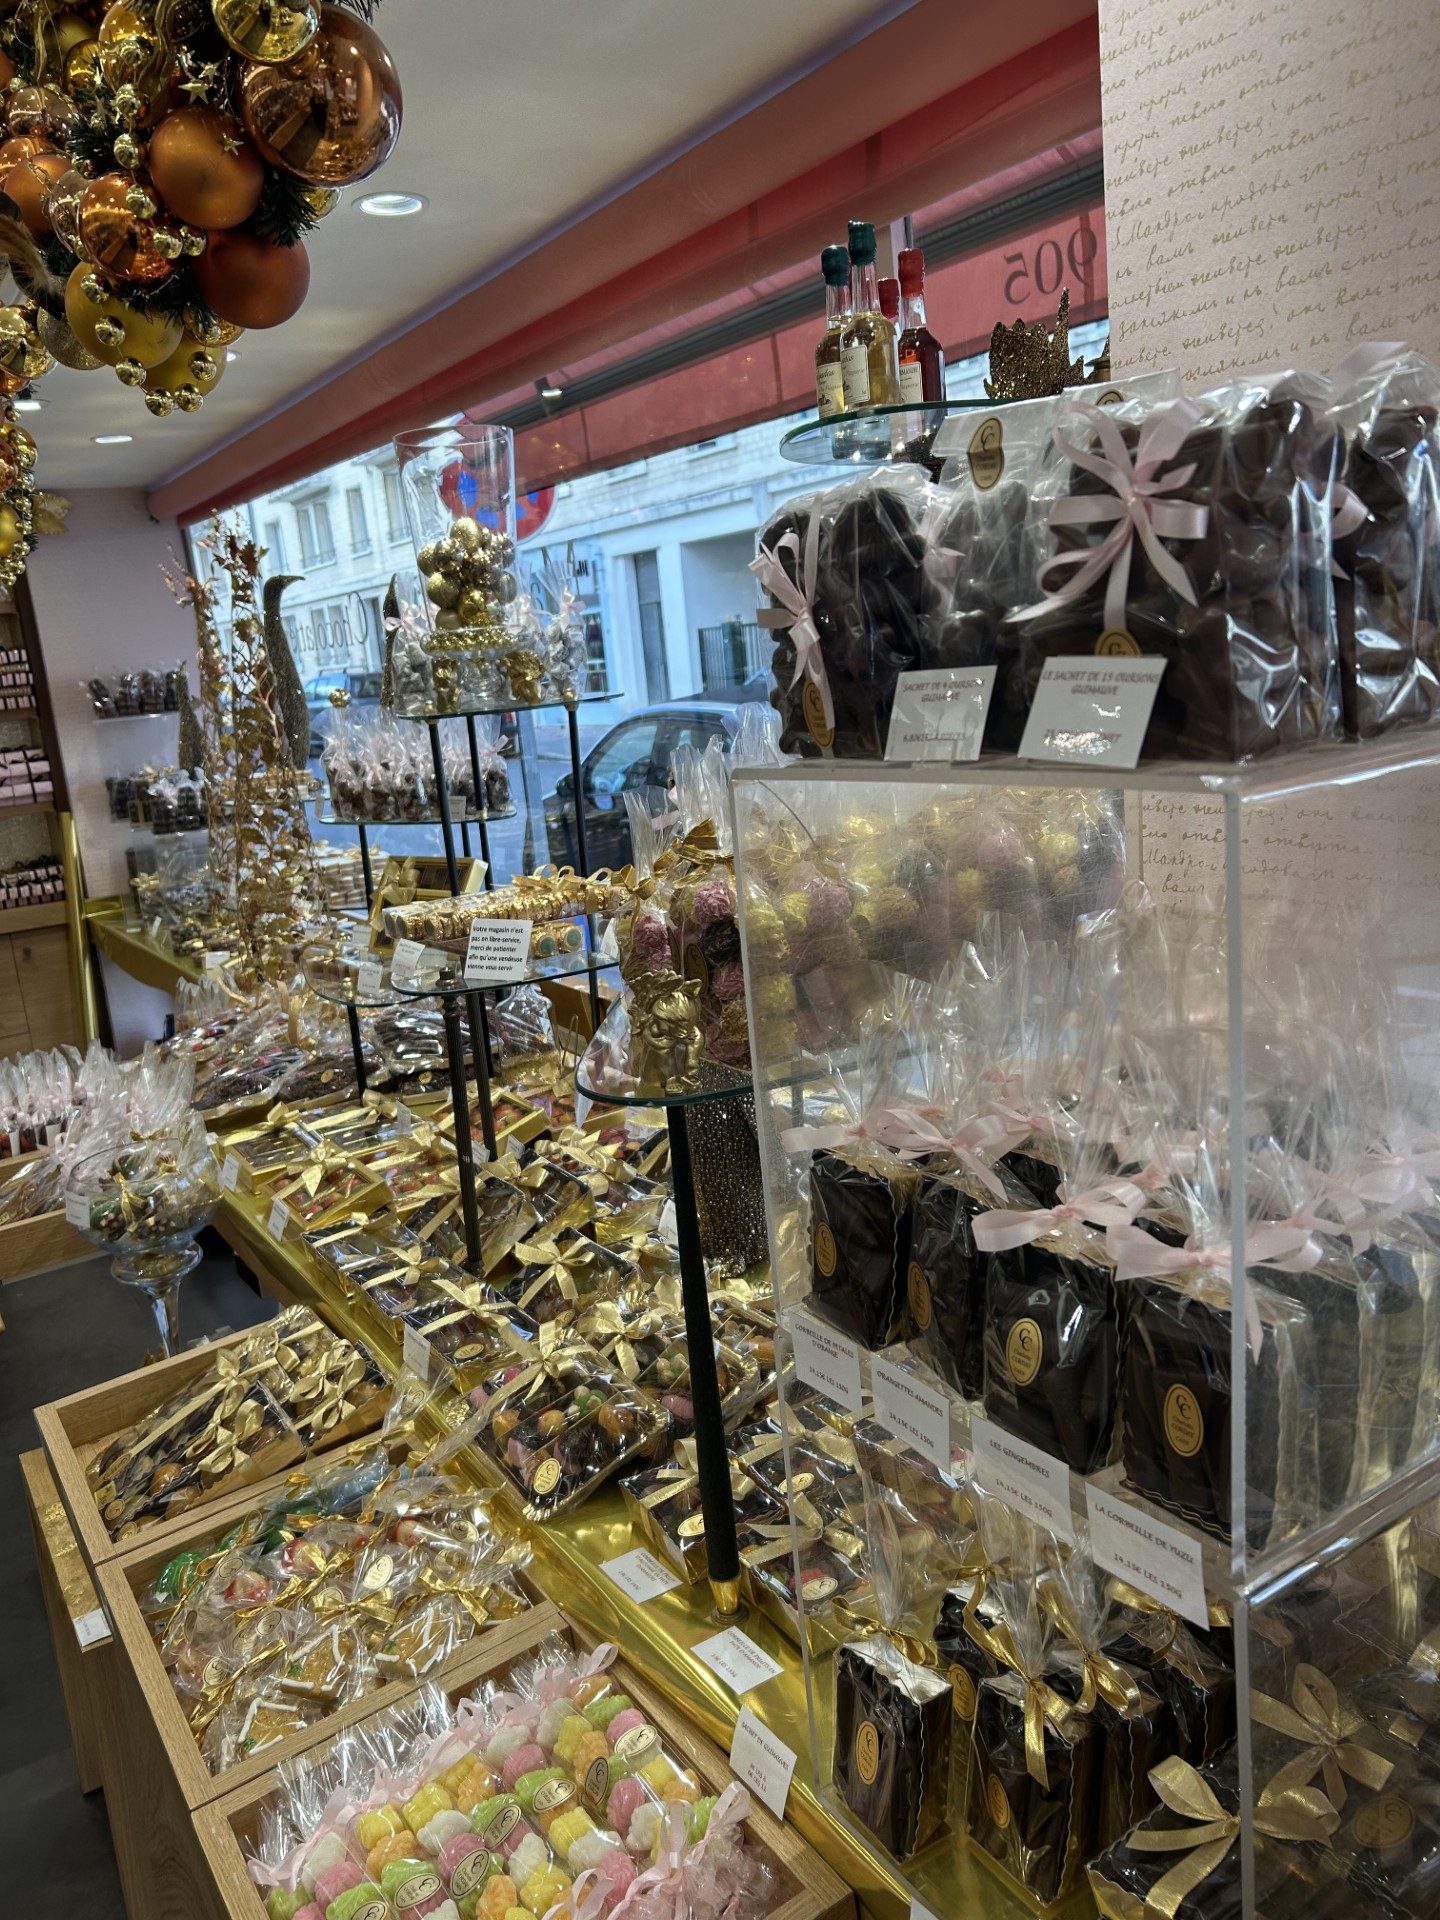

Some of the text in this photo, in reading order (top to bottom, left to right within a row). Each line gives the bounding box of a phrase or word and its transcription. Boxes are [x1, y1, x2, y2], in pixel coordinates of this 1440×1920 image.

[1087, 671, 1099, 681] DE
[488, 926, 509, 934] magasin
[489, 936, 521, 944] libre-service,
[480, 954, 498, 962] qu'une
[795, 1323, 823, 1342] CORBEILLE
[824, 1337, 831, 1346] DE
[826, 1375, 835, 1386] LES
[876, 1370, 943, 1418] ORANGETTES AMANDES
[889, 1411, 934, 1448] 14,15€ LES 150G
[990, 1439, 1050, 1479] LES GINGEMBRES
[995, 1478, 1053, 1518] 14,15€ LES 150G
[1095, 1503, 1194, 1564] LA CORBEILLE DE YUZU
[1114, 1553, 1183, 1599] 14,15€ LES 150G
[727, 1630, 751, 1650] CORBEILLE
[742, 1721, 758, 1739] SACHET
[756, 1736, 764, 1746] DE
